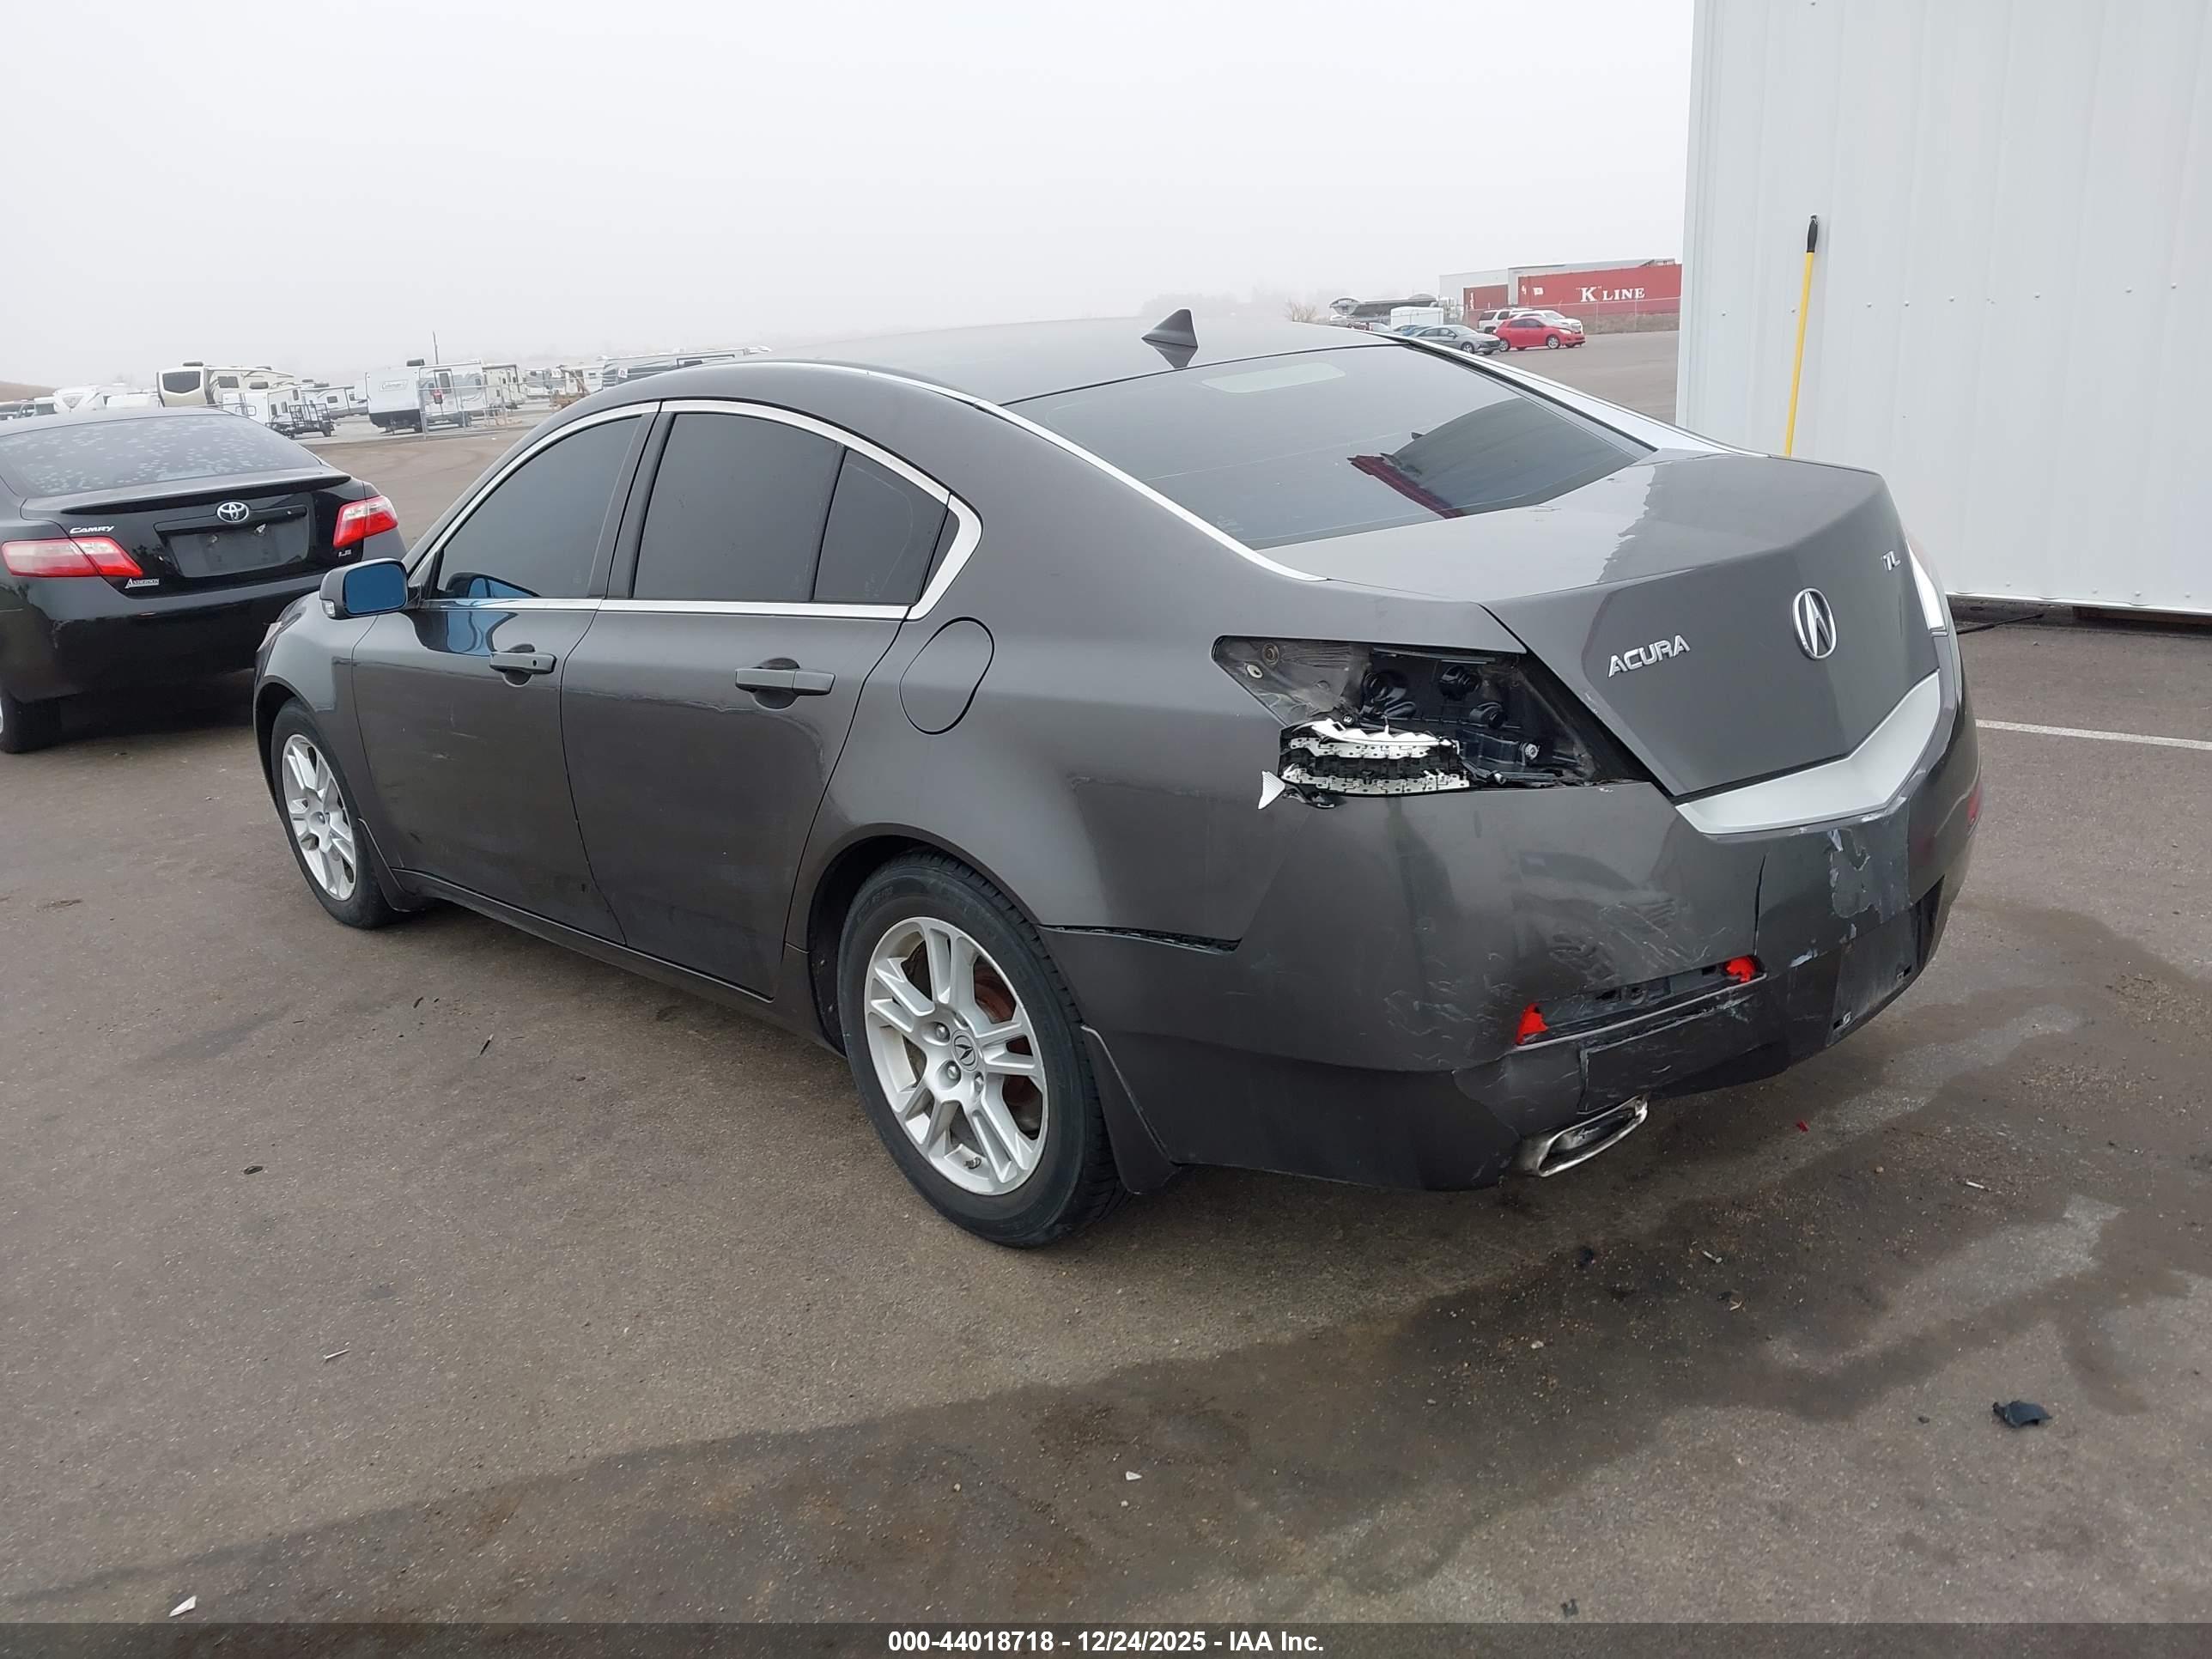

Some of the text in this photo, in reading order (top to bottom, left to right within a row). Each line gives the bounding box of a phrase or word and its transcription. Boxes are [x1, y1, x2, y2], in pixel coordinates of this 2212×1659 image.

[1602, 288, 1645, 301] LINE
[70, 525, 115, 534] CAMRY
[1881, 550, 1901, 571] TL
[1608, 635, 1690, 678] ACURA
